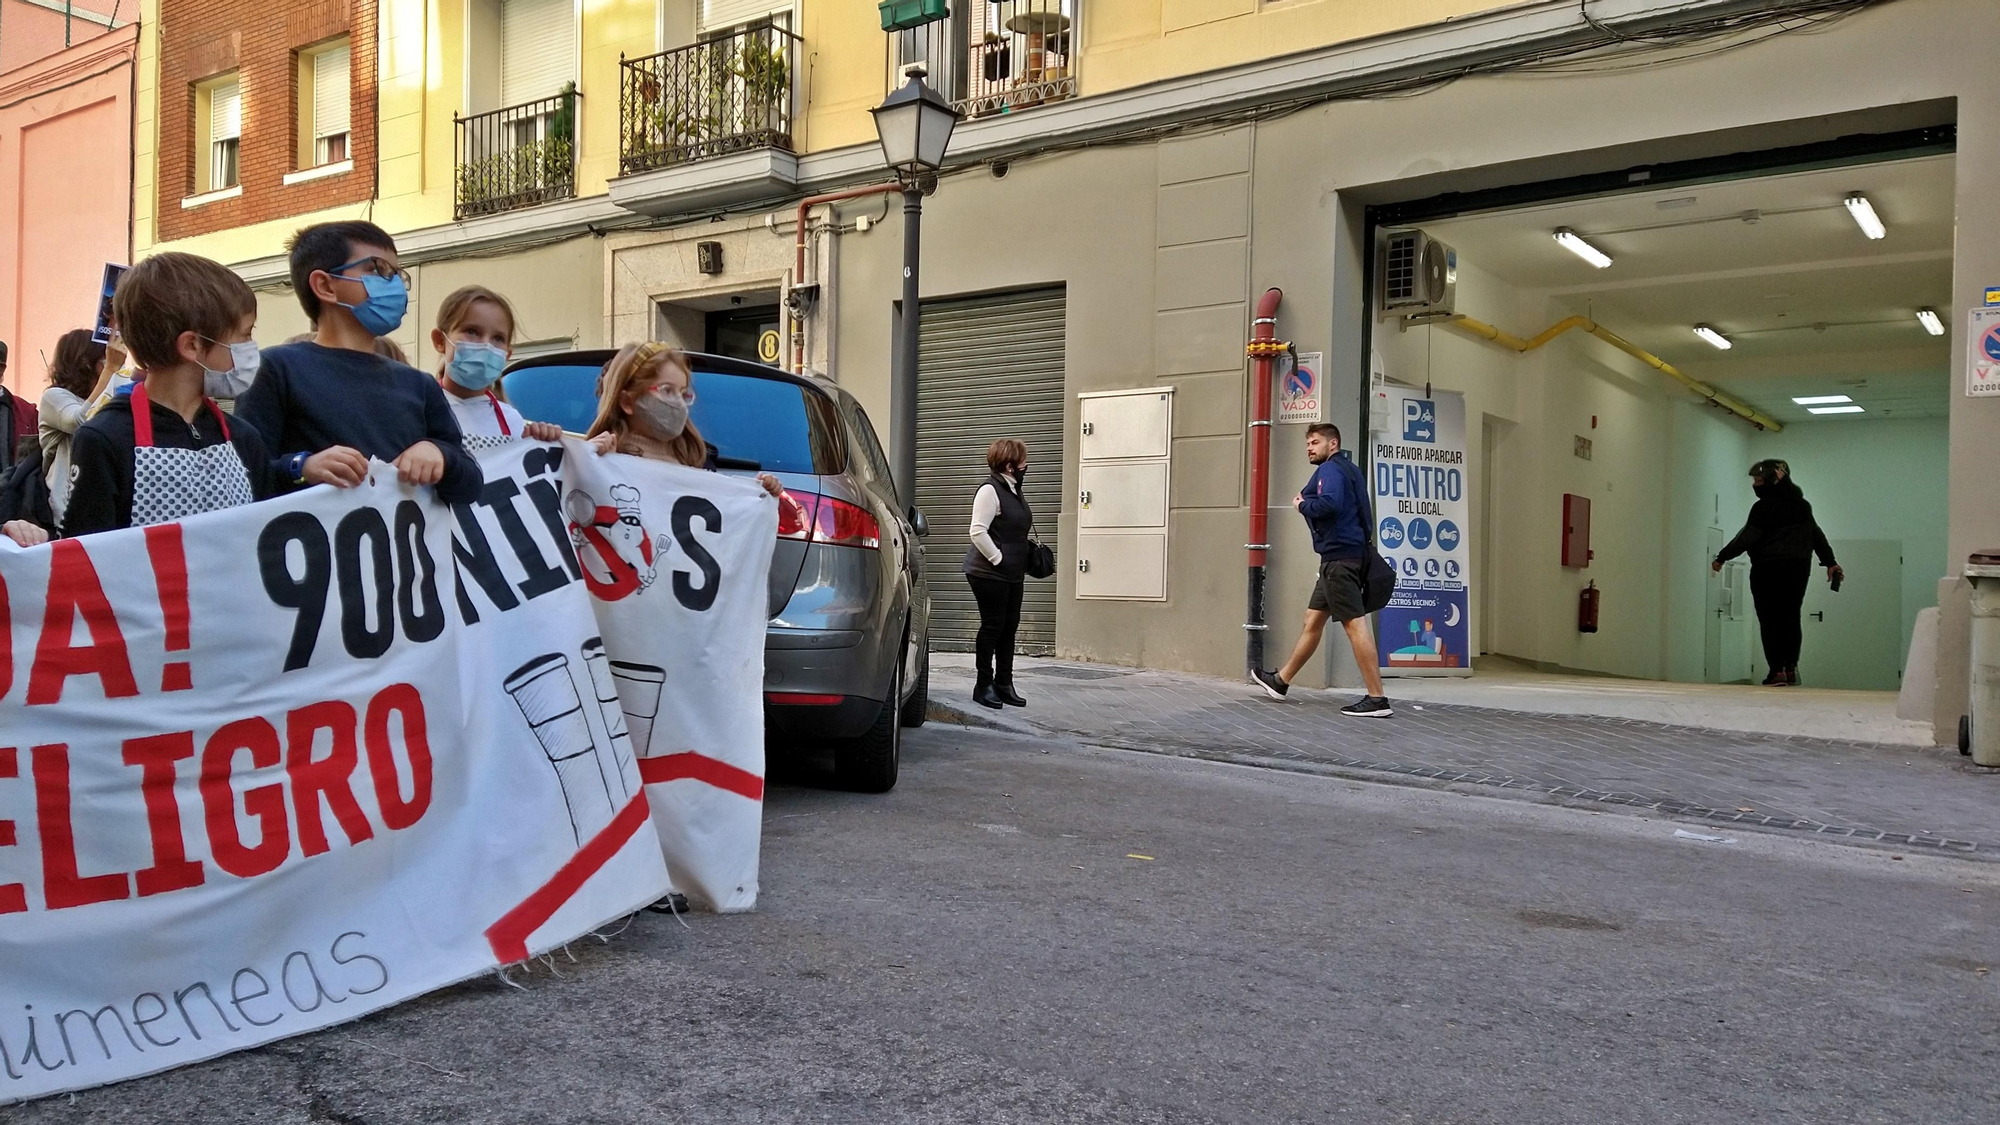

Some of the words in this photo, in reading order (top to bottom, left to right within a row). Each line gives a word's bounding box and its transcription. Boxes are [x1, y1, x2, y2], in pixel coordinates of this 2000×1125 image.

[765, 335, 775, 357] 8
[1282, 400, 1317, 411] VADO
[1404, 400, 1422, 433] P
[1377, 444, 1394, 459] POR
[1396, 446, 1423, 461] FAVOR
[1425, 448, 1463, 464] APARCAR
[1377, 462, 1462, 502] DENTRO
[1398, 500, 1414, 514] DEL
[1416, 501, 1444, 516] LOCAL.
[257, 500, 445, 673] 900
[0, 522, 193, 706] A!
[1412, 599, 1436, 607] VECINOS
